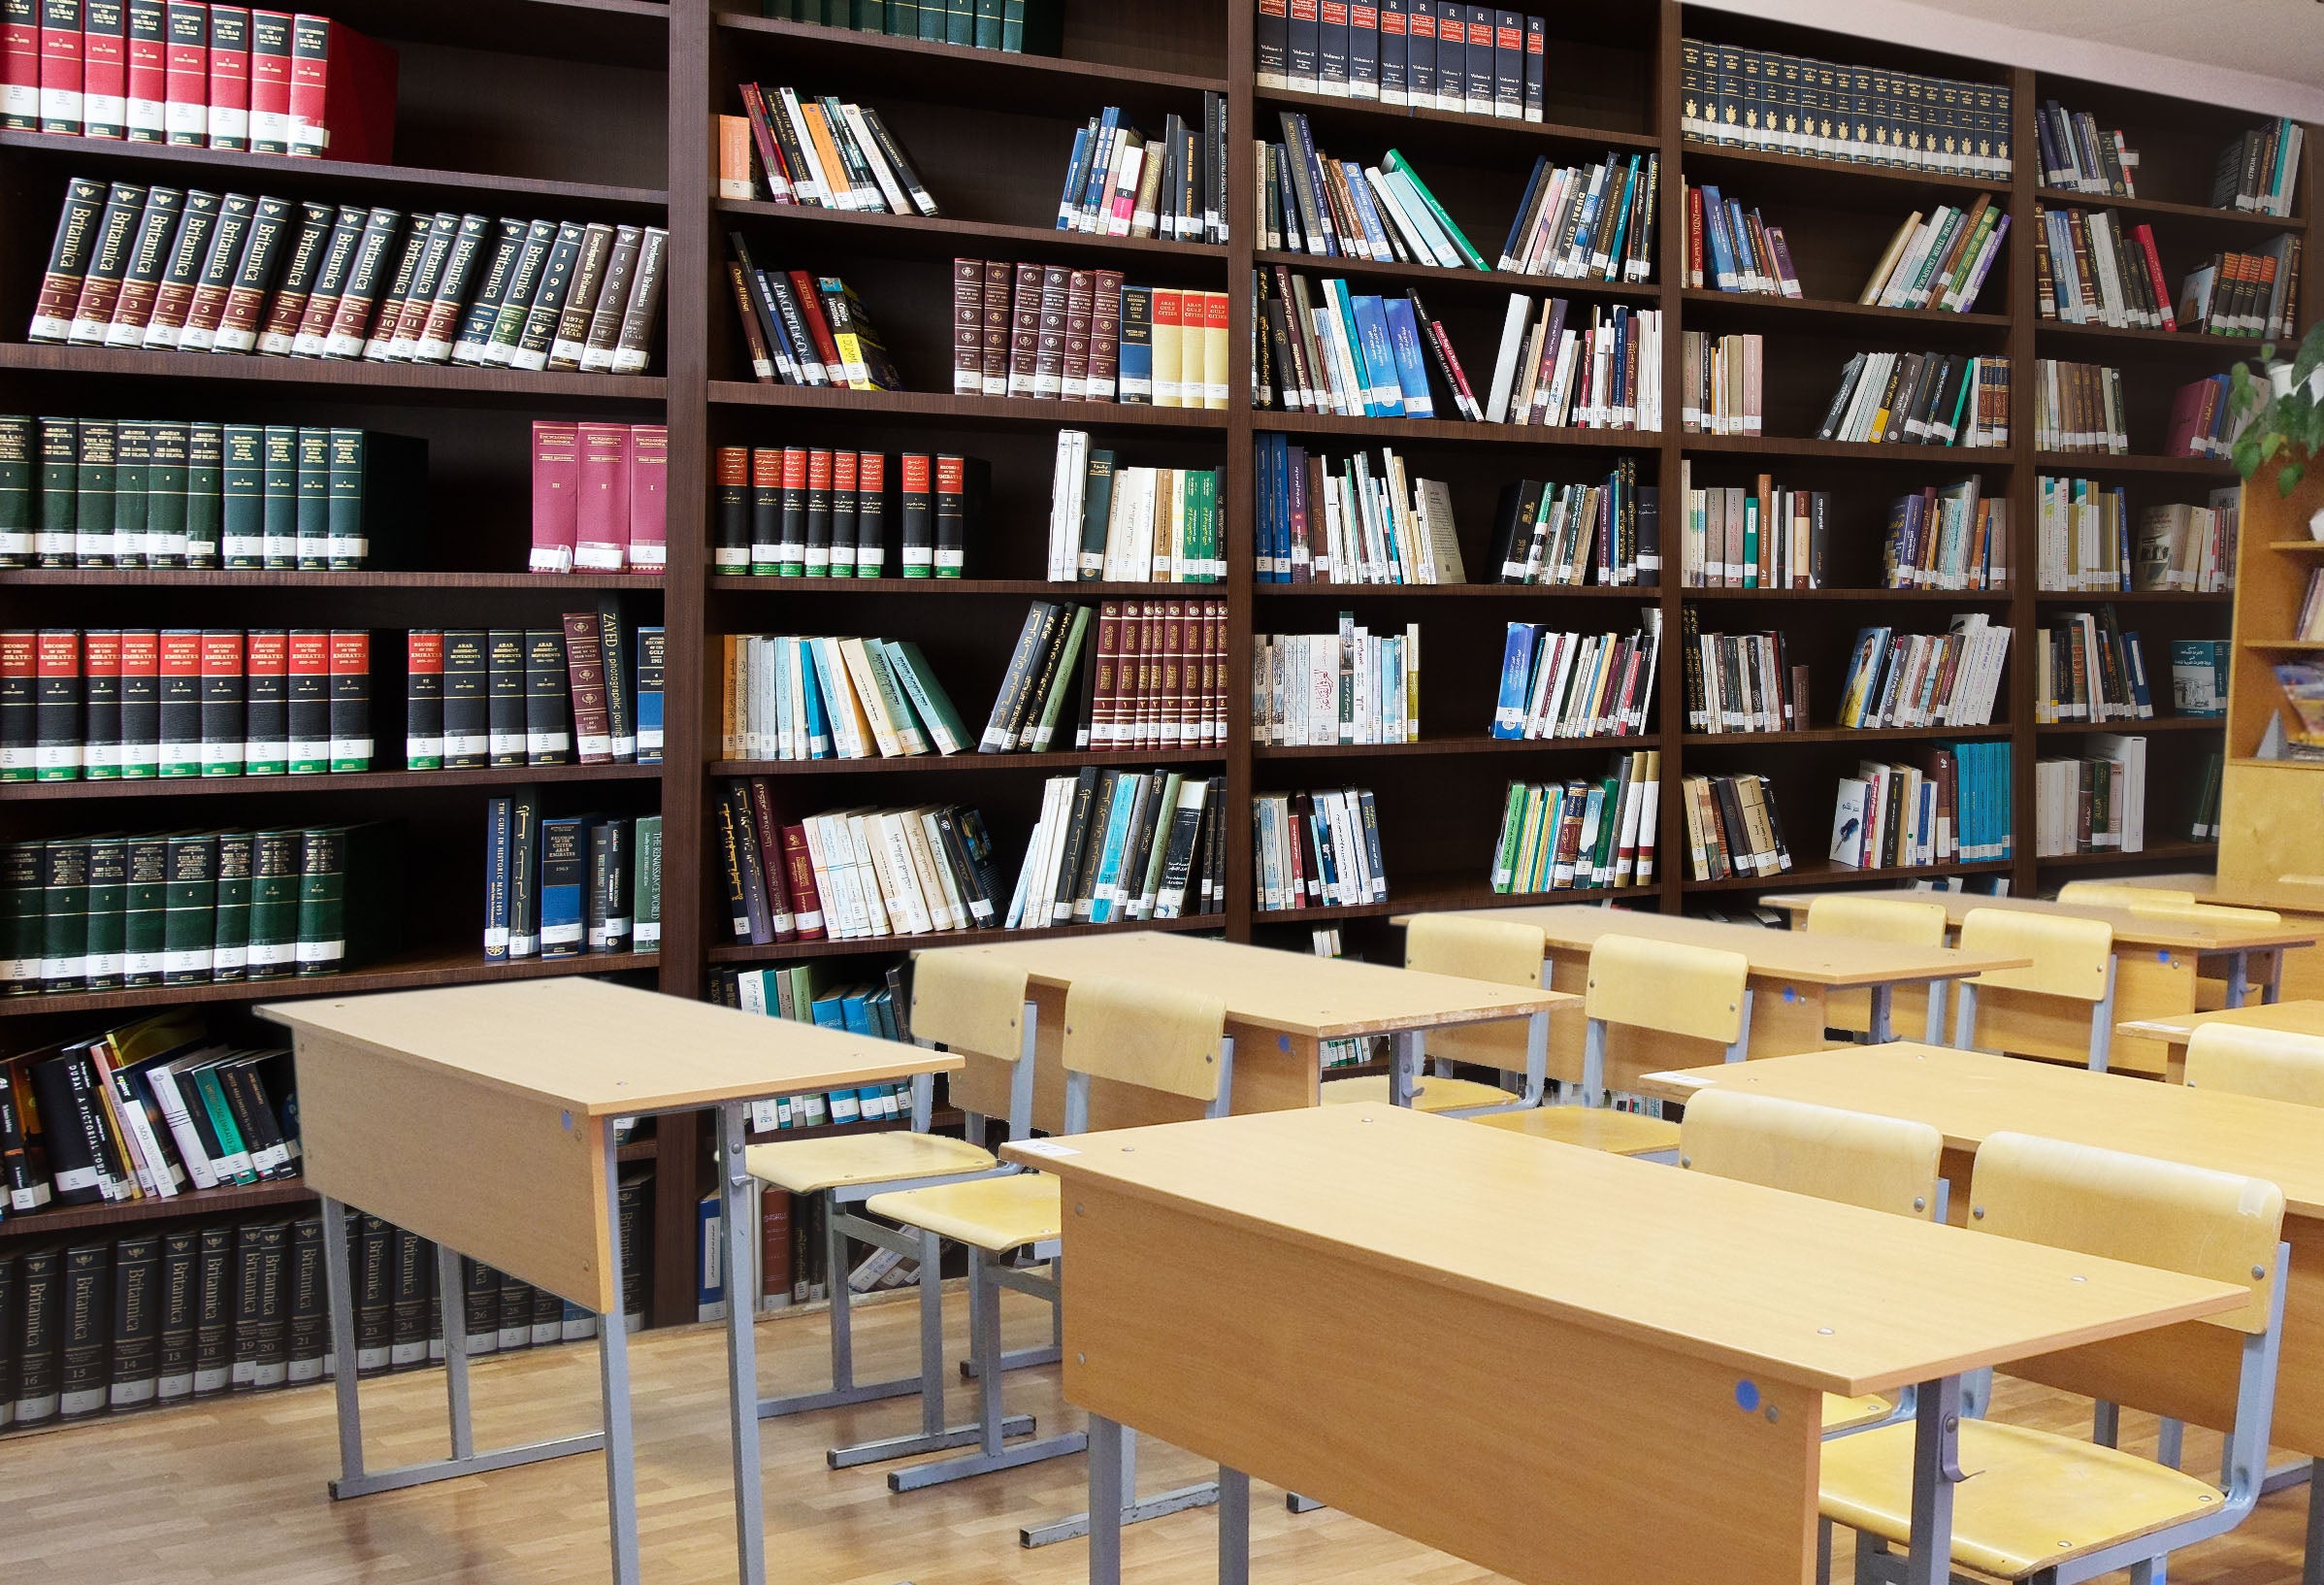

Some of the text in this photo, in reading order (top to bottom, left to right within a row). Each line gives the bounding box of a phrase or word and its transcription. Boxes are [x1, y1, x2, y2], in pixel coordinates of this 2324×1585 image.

[1296, 171, 1306, 182] THE
[1299, 183, 1311, 204] UNITED
[59, 207, 91, 268] Britannica
[99, 210, 131, 271] Britannica
[1304, 205, 1315, 221] ARAB
[1563, 190, 1586, 249] DUBAI CITY
[136, 215, 168, 274] Britannica
[174, 217, 207, 276] Britannica
[210, 220, 241, 279] Britannica
[244, 223, 276, 281] Britannica
[287, 229, 320, 286] Britannica
[321, 232, 353, 290] Britannica
[354, 234, 386, 290] Britannica
[393, 241, 424, 295] Britannica
[417, 240, 448, 293] Britannica
[442, 240, 475, 294] Britannica
[484, 244, 515, 299] Britannica
[512, 246, 543, 299] Britannica
[1915, 214, 1956, 289] BEFORE THEIR DIASPORA
[130, 300, 137, 309] 3
[279, 311, 287, 319] 7
[575, 272, 594, 305] Britannica
[828, 298, 841, 327] Vacations
[837, 302, 848, 322] Cruise
[381, 319, 394, 328] 10
[407, 318, 417, 327] 11
[432, 319, 444, 328] 12
[603, 613, 617, 646] ZAYED
[608, 658, 621, 710] photographic
[650, 831, 661, 919] THE RENAISSANCE WORLD
[68, 1065, 82, 1089] DUBAI
[80, 1106, 95, 1152] PICTORIAL
[94, 1155, 106, 1174] TOUR
[402, 1237, 418, 1296] Britannica
[620, 1211, 634, 1269] Britannica
[171, 1262, 188, 1324] Britannica
[205, 1258, 222, 1320] Britannica
[263, 1254, 279, 1315] Britannica
[300, 1248, 316, 1309] Britannica
[367, 1240, 384, 1300] Britannica
[26, 1283, 47, 1347] Britannica
[75, 1276, 93, 1340] Britannica
[125, 1269, 146, 1332] Britannica
